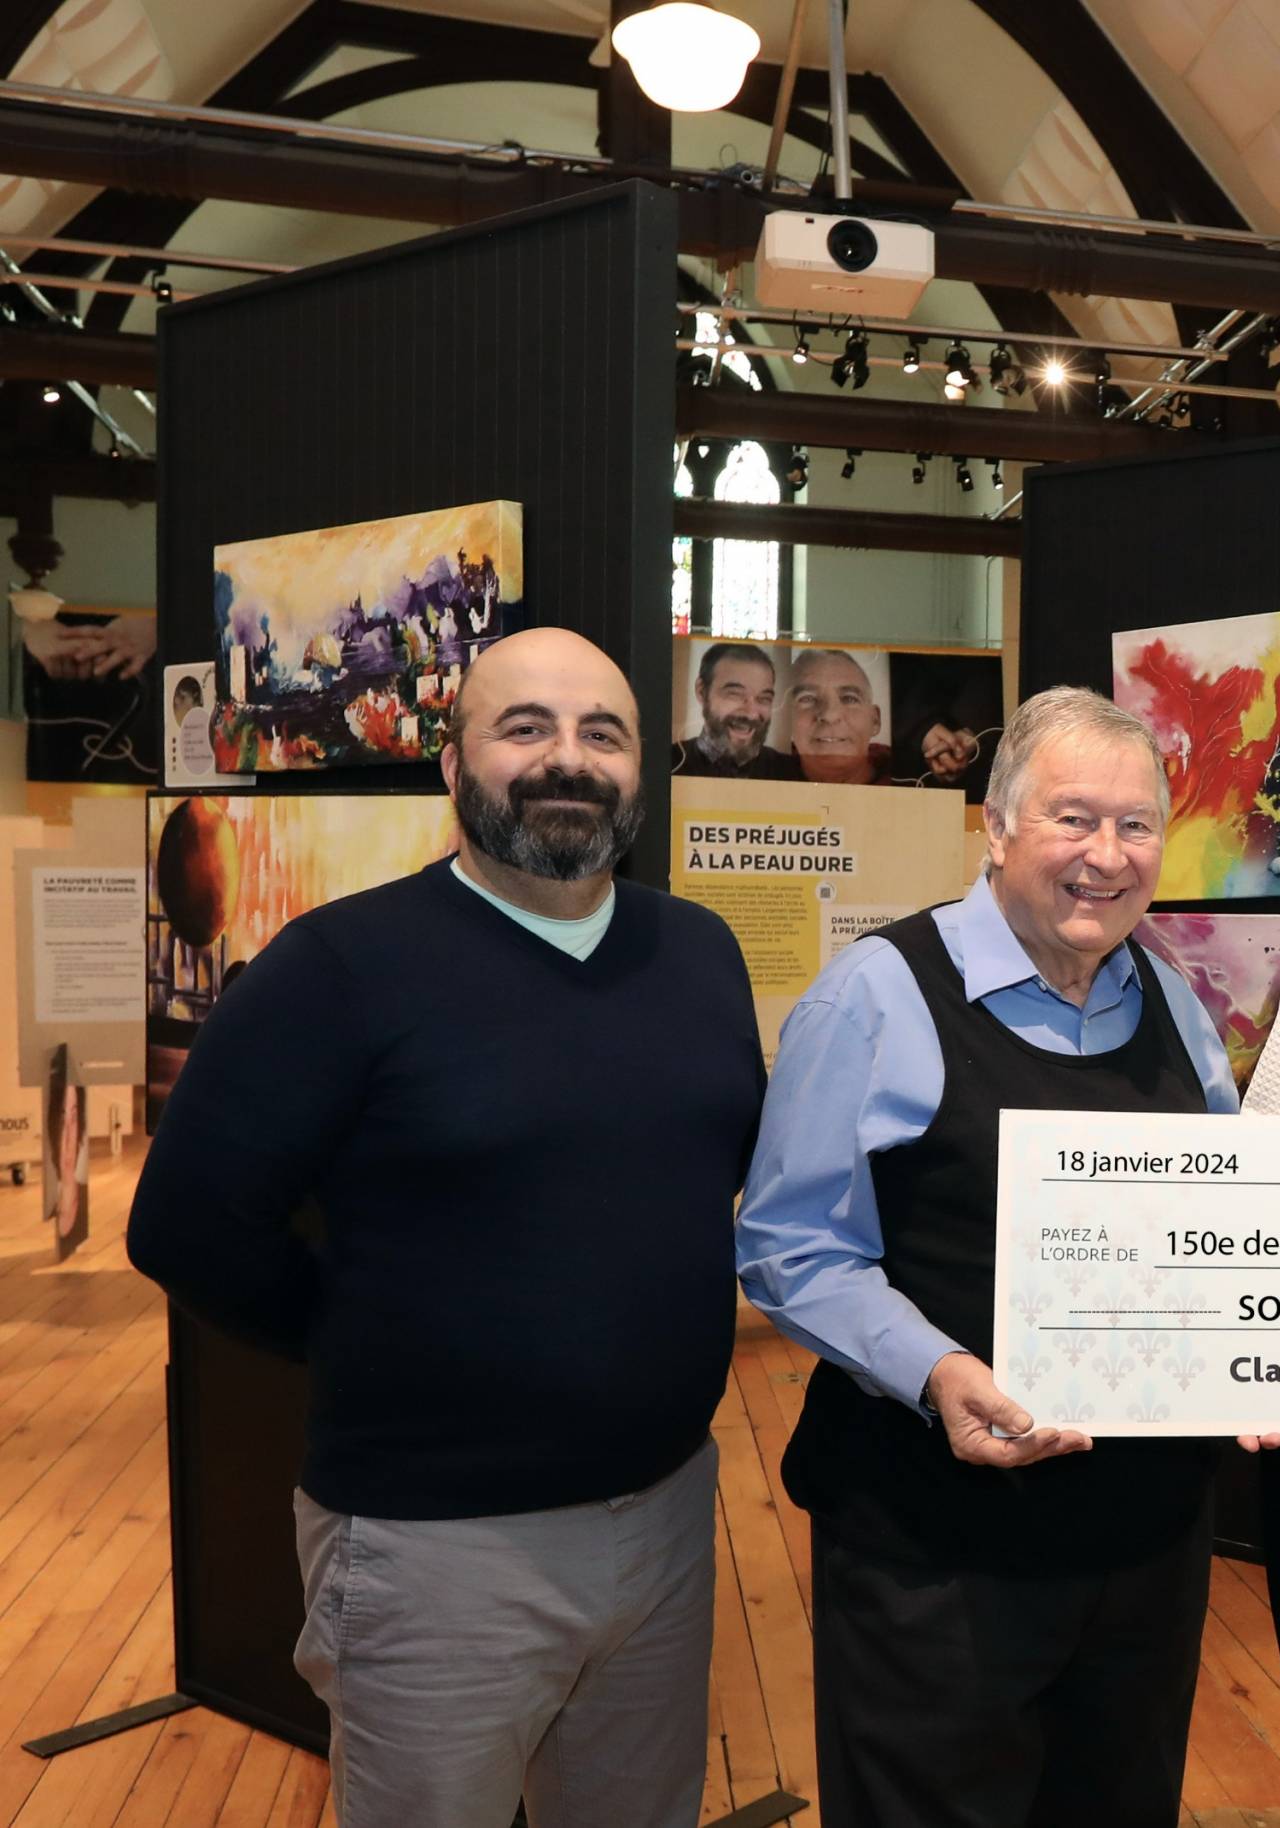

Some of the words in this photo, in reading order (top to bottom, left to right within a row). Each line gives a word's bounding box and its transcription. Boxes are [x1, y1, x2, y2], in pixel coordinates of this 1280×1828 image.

[689, 826, 730, 844] DES
[736, 825, 840, 847] PRÉJUGÉS
[689, 849, 703, 869] À
[709, 853, 735, 870] LA
[740, 854, 795, 871] PEAU
[800, 856, 853, 872] DURE
[832, 926, 837, 934] À
[1058, 1151, 1084, 1171] 18
[1090, 1152, 1173, 1177] janvier
[1180, 1154, 1238, 1174] 2024
[1042, 1228, 1091, 1241] PAYEZ
[1097, 1224, 1109, 1242] À
[1168, 1231, 1234, 1255] 150e
[1244, 1230, 1279, 1255] de
[1117, 1249, 1137, 1261] DE
